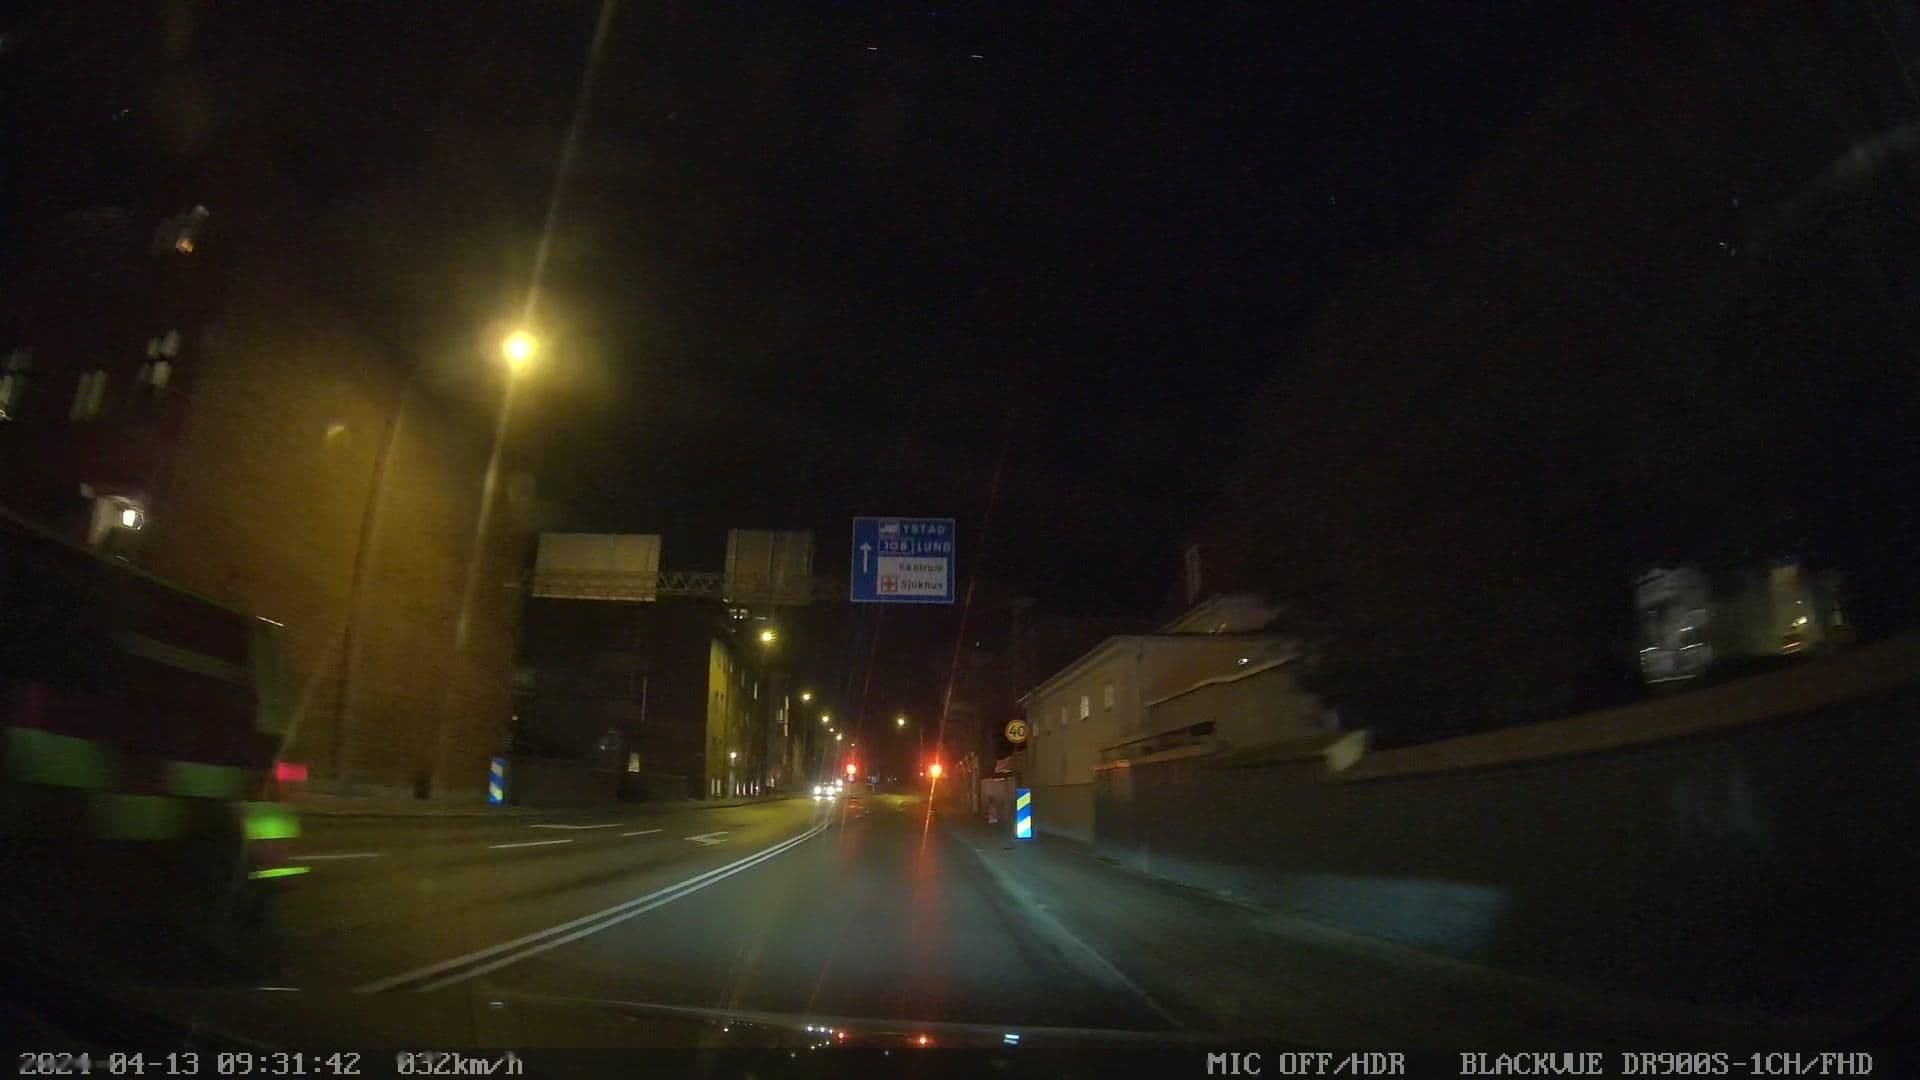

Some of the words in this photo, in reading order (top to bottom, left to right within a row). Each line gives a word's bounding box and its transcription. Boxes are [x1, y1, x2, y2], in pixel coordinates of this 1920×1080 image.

[903, 524, 945, 534] YSTAD
[917, 542, 951, 553] LUND
[901, 580, 943, 591] Sjukhus
[1009, 725, 1025, 737] 40
